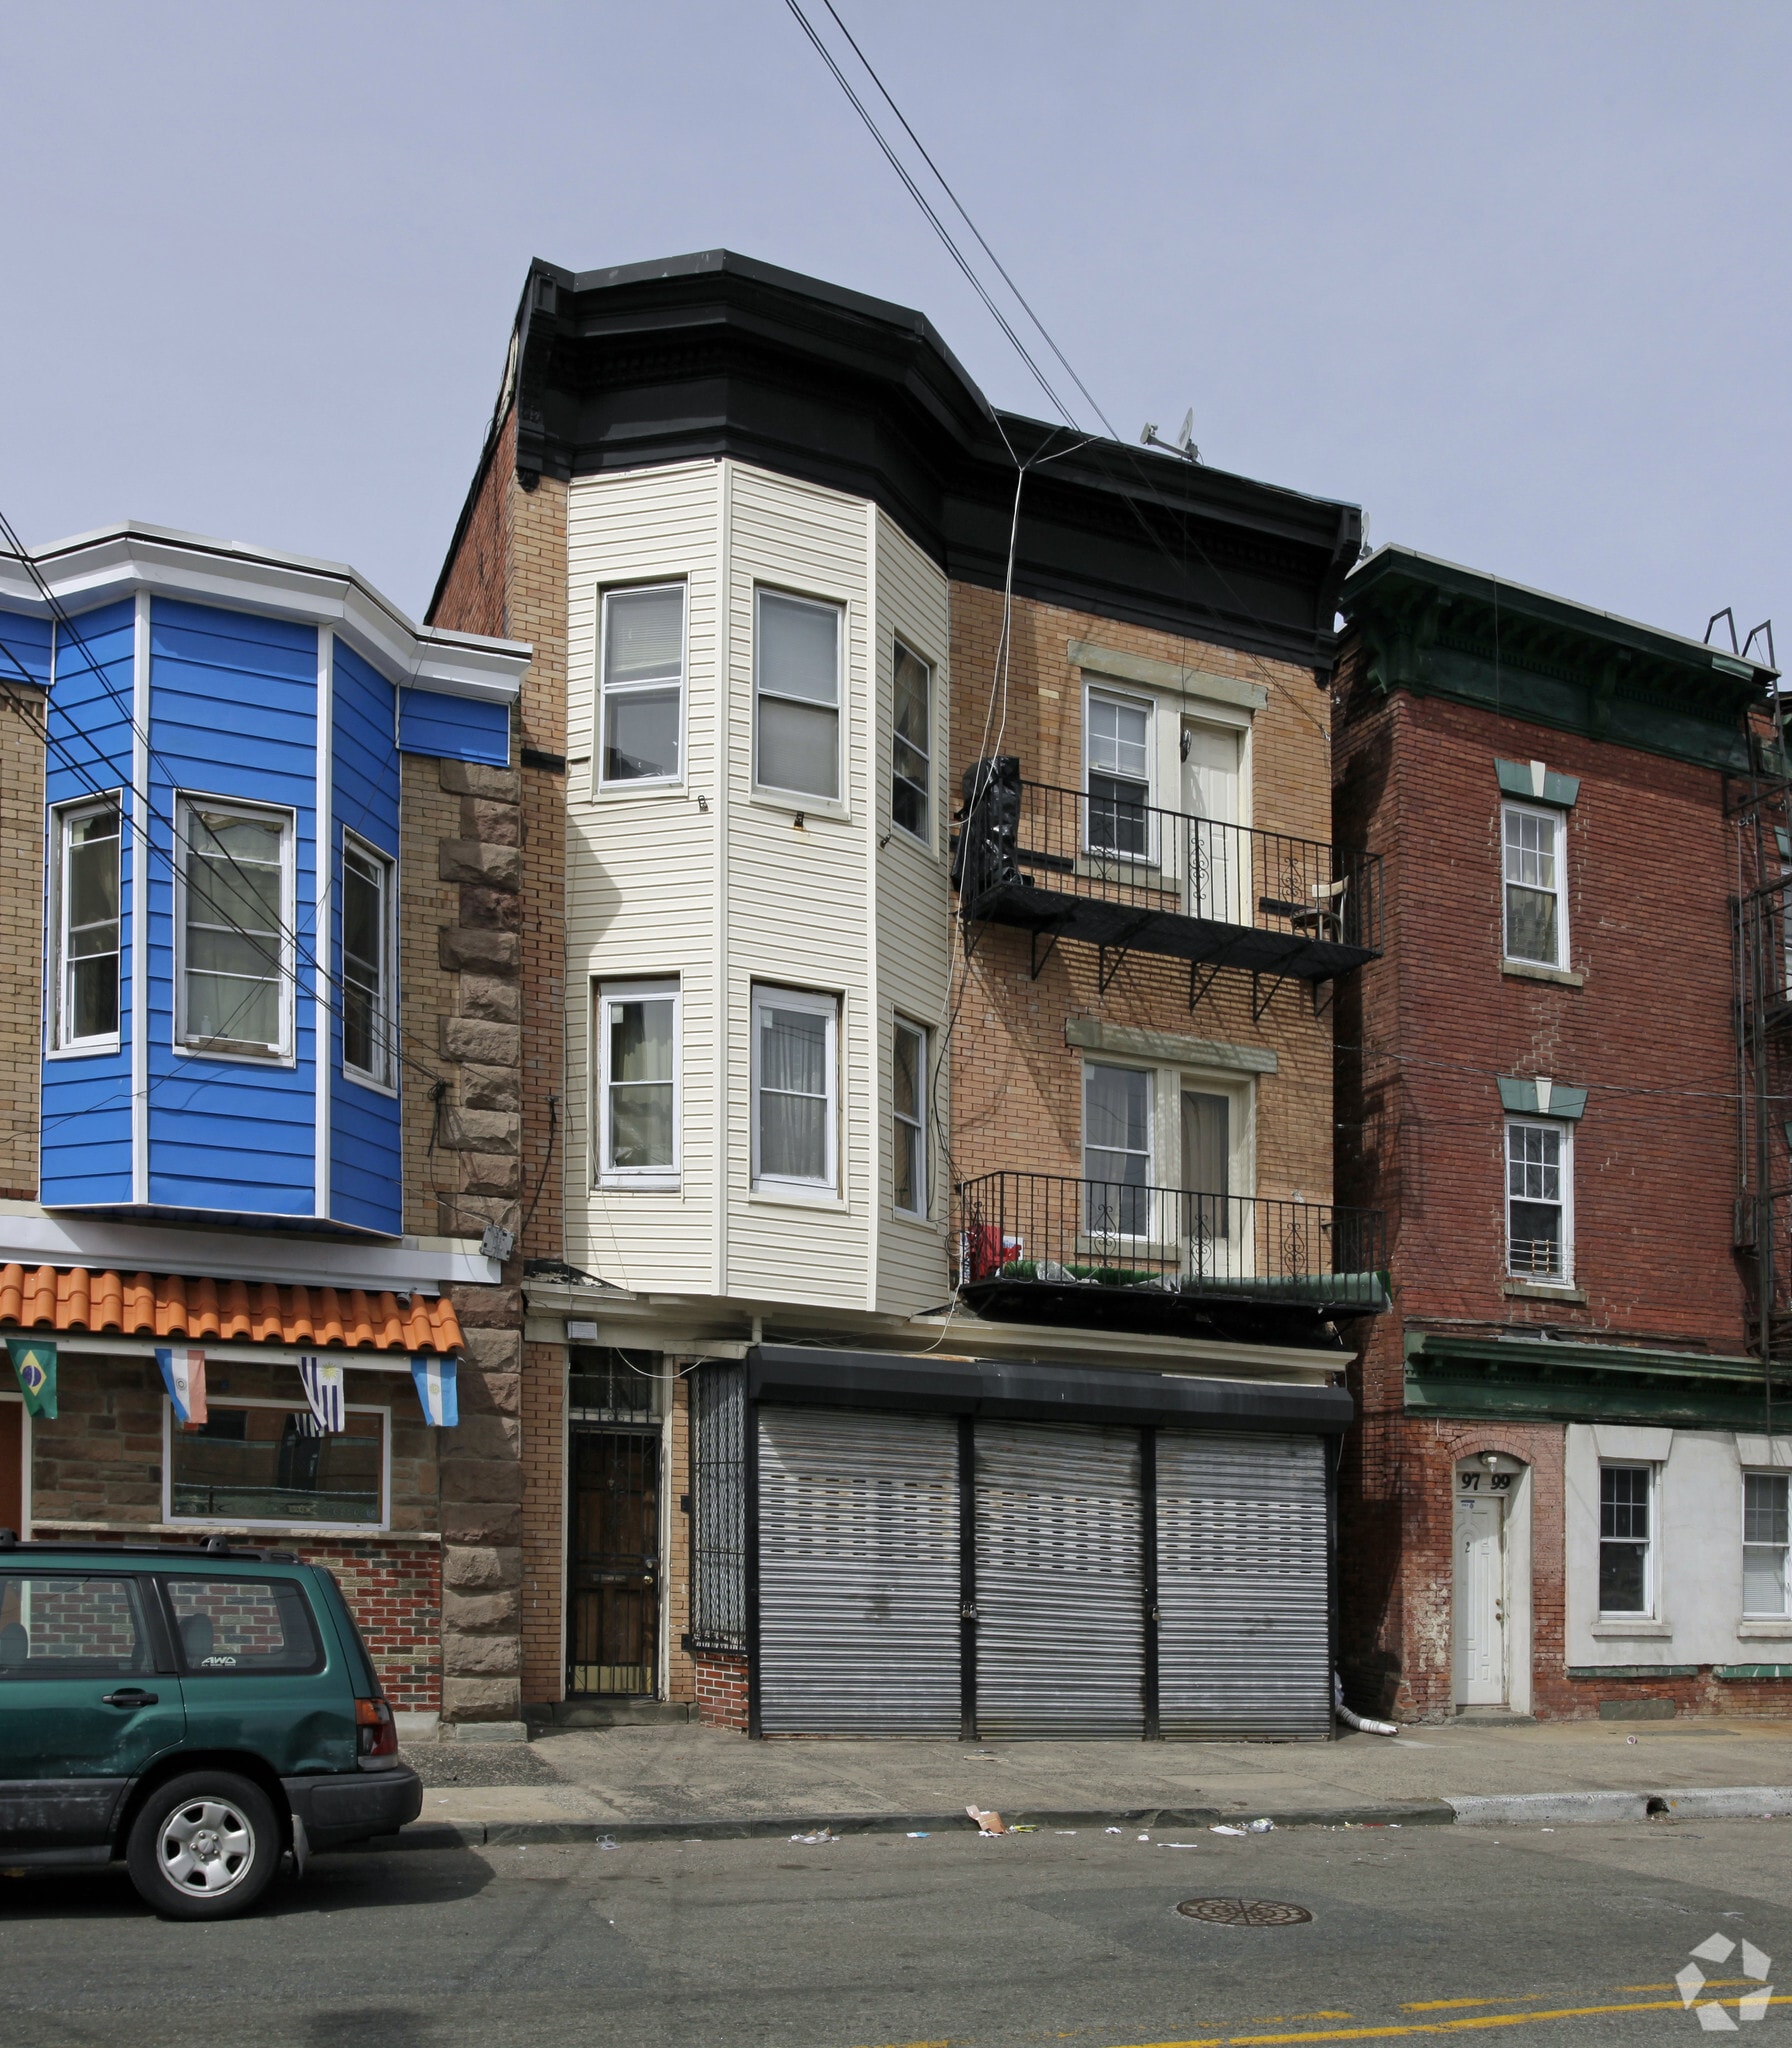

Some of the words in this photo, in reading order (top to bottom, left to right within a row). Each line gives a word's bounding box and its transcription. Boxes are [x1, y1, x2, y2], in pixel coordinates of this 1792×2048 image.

[1461, 1472, 1481, 1491] 97
[1490, 1473, 1511, 1490] 99
[1465, 1541, 1471, 1553] 2
[201, 1656, 237, 1664] AWD
